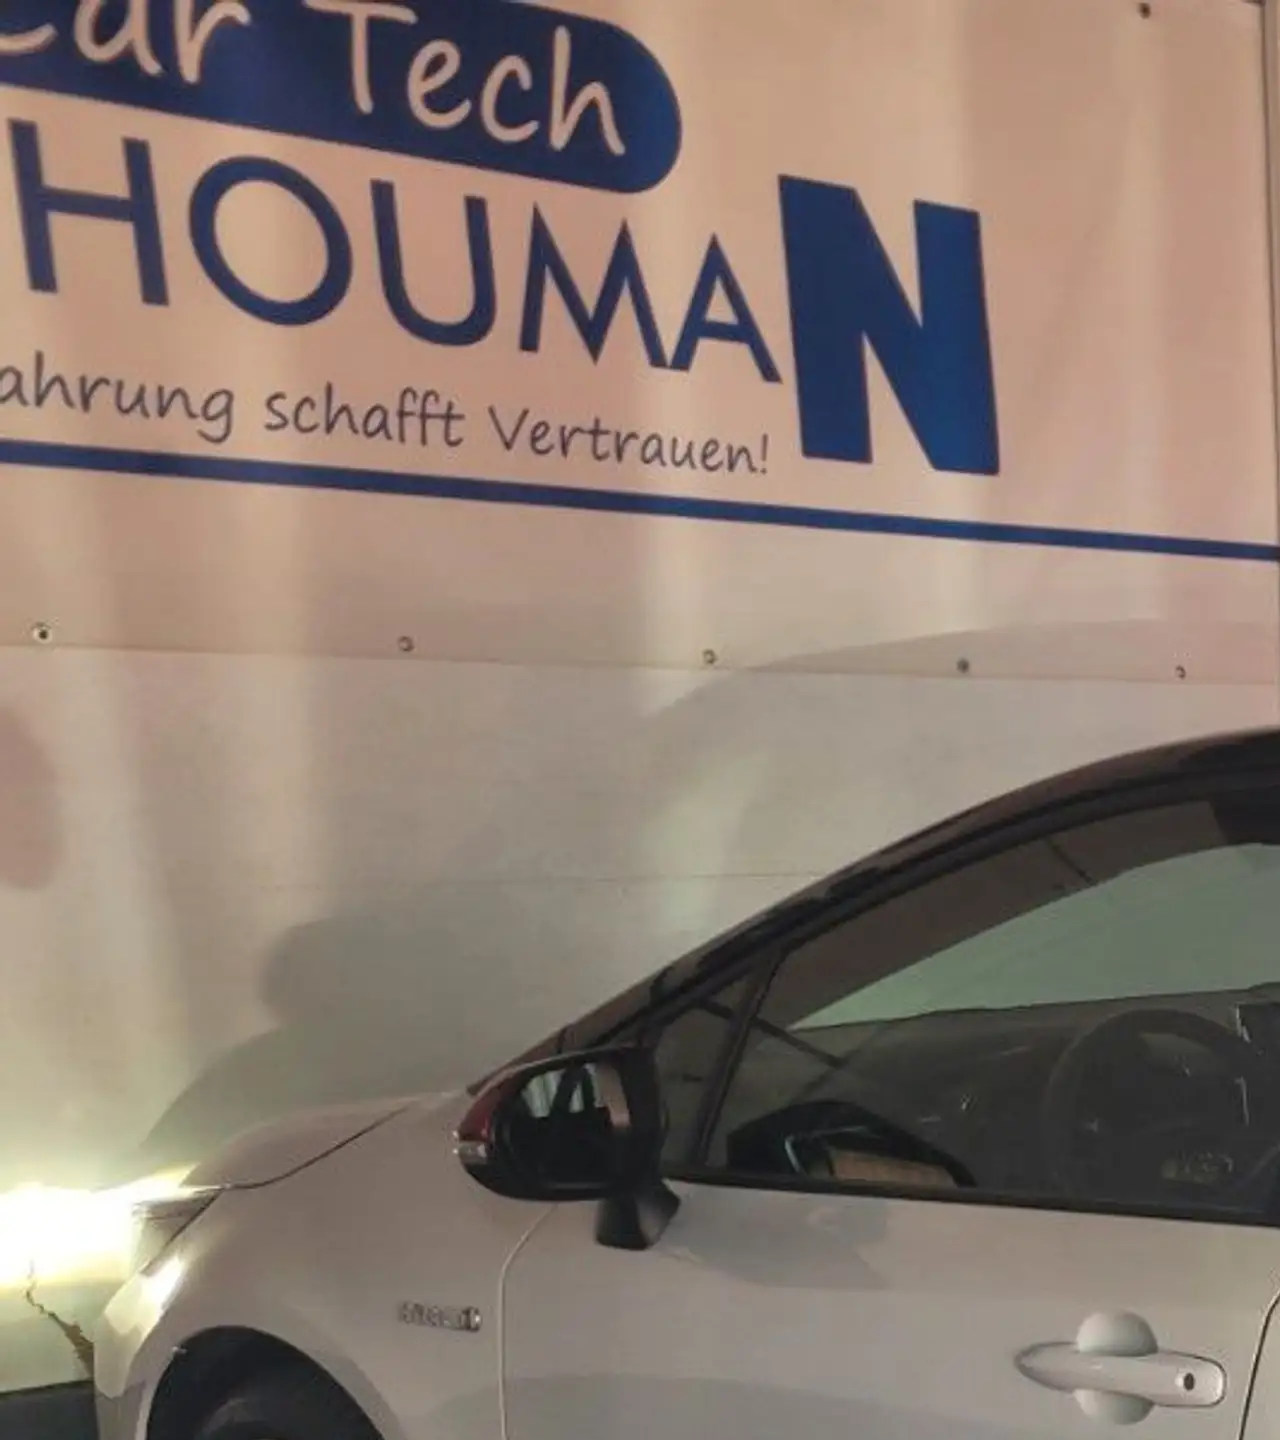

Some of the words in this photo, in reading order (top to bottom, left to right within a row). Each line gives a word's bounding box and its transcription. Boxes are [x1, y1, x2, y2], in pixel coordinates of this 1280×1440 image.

[0, 0, 252, 84] ar
[310, 0, 627, 157] Tech
[6, 117, 1001, 476] HOUMAN
[264, 383, 466, 448] schafft
[487, 405, 771, 476] Vertrauen!
